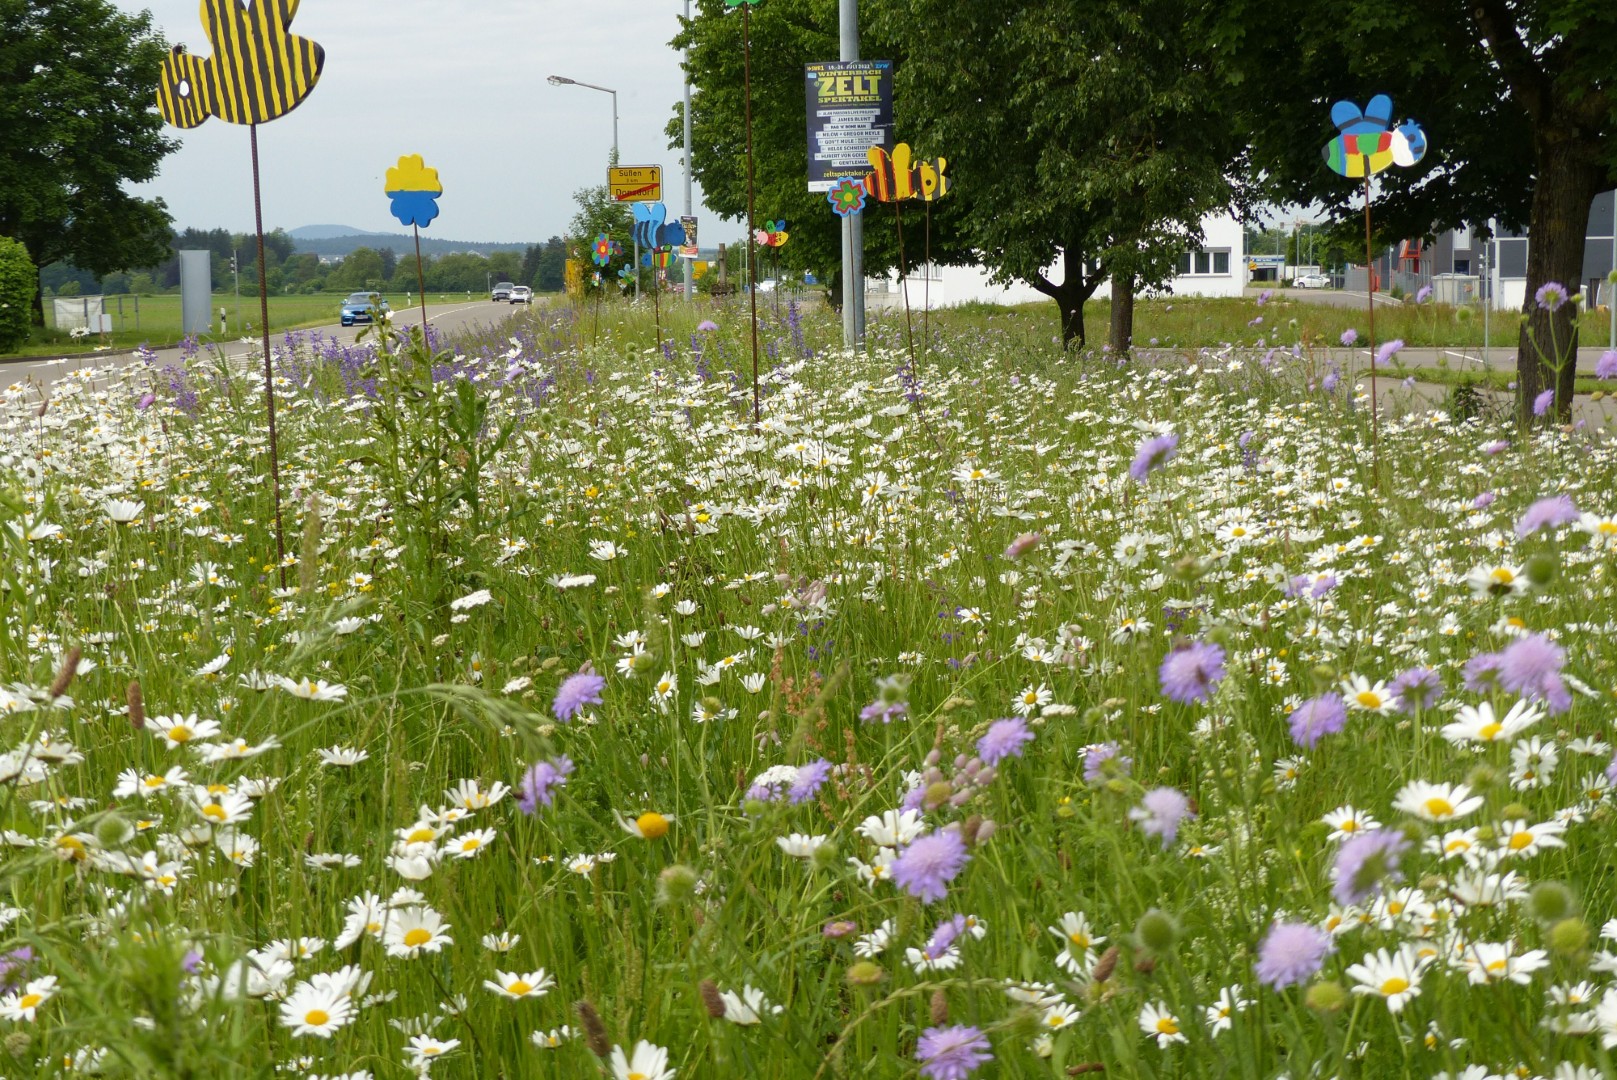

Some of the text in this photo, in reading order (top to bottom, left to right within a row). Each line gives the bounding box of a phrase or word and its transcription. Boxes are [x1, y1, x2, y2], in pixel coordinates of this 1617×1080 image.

[818, 76, 882, 96] ZELT
[618, 169, 642, 177] Süßen
[823, 170, 873, 178] zeltspektakel.co
